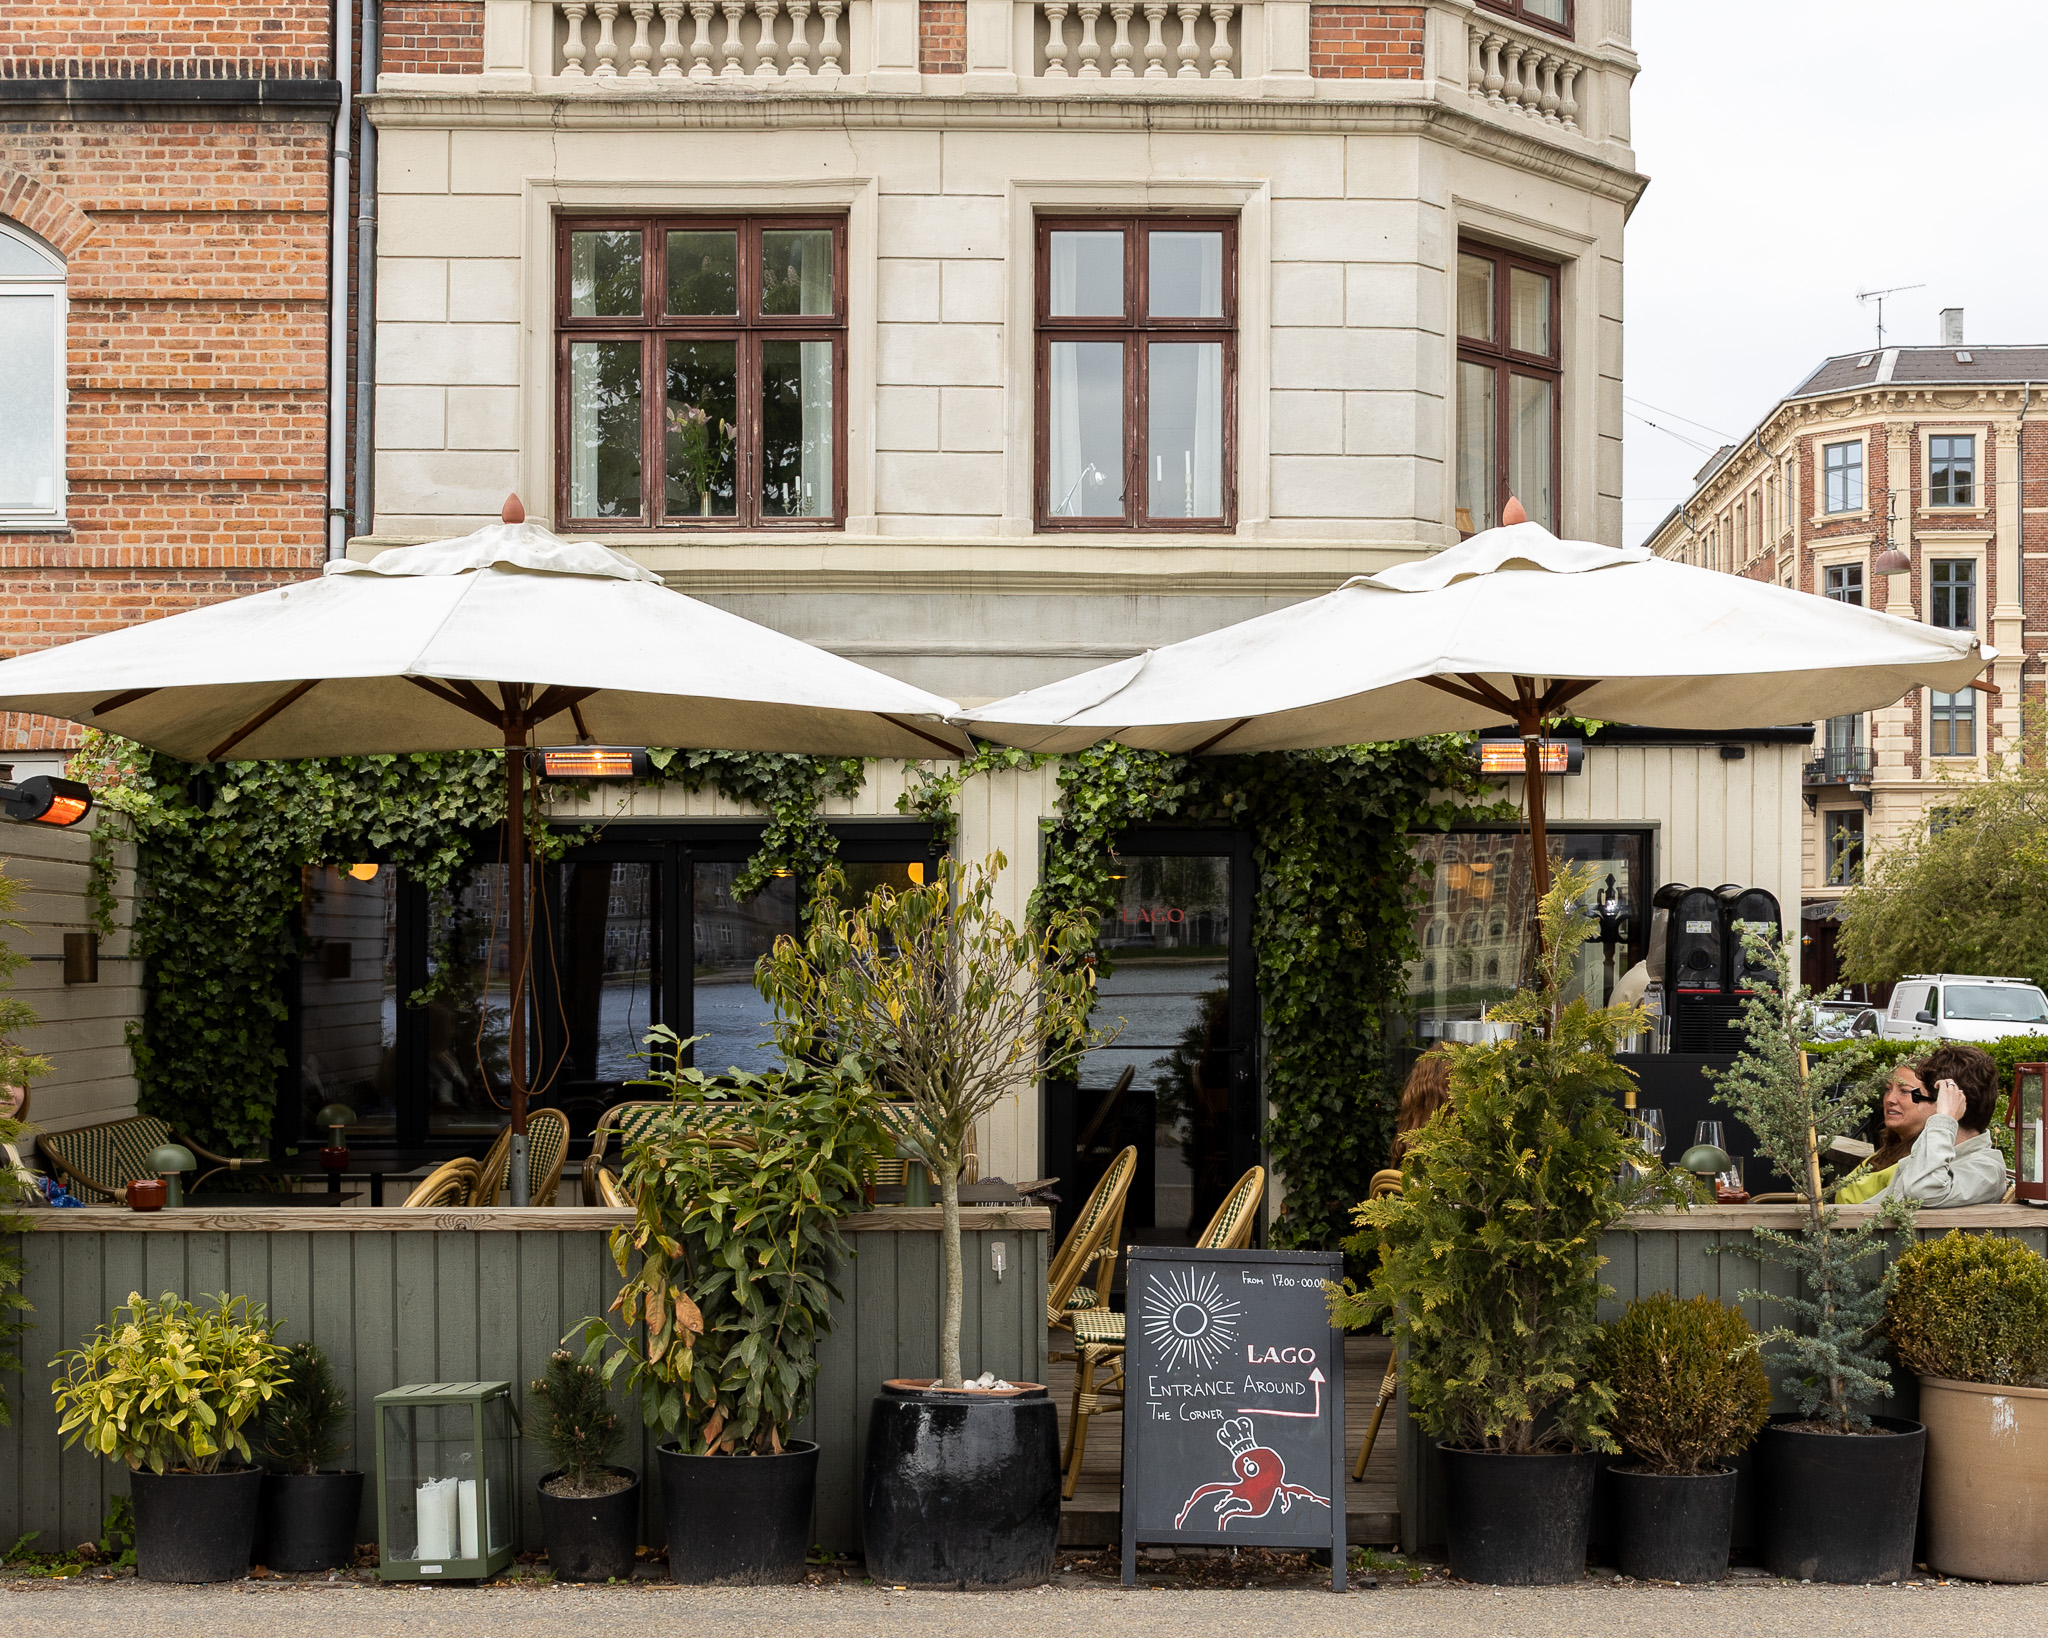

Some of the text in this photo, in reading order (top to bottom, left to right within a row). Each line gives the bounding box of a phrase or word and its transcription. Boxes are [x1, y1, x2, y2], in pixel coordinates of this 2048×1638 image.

[1122, 908, 1185, 923] LAGO
[1247, 1344, 1317, 1364] LAGO
[1148, 1374, 1306, 1397] ENTRANCE AROUND
[1146, 1401, 1225, 1422] THE CORNER
